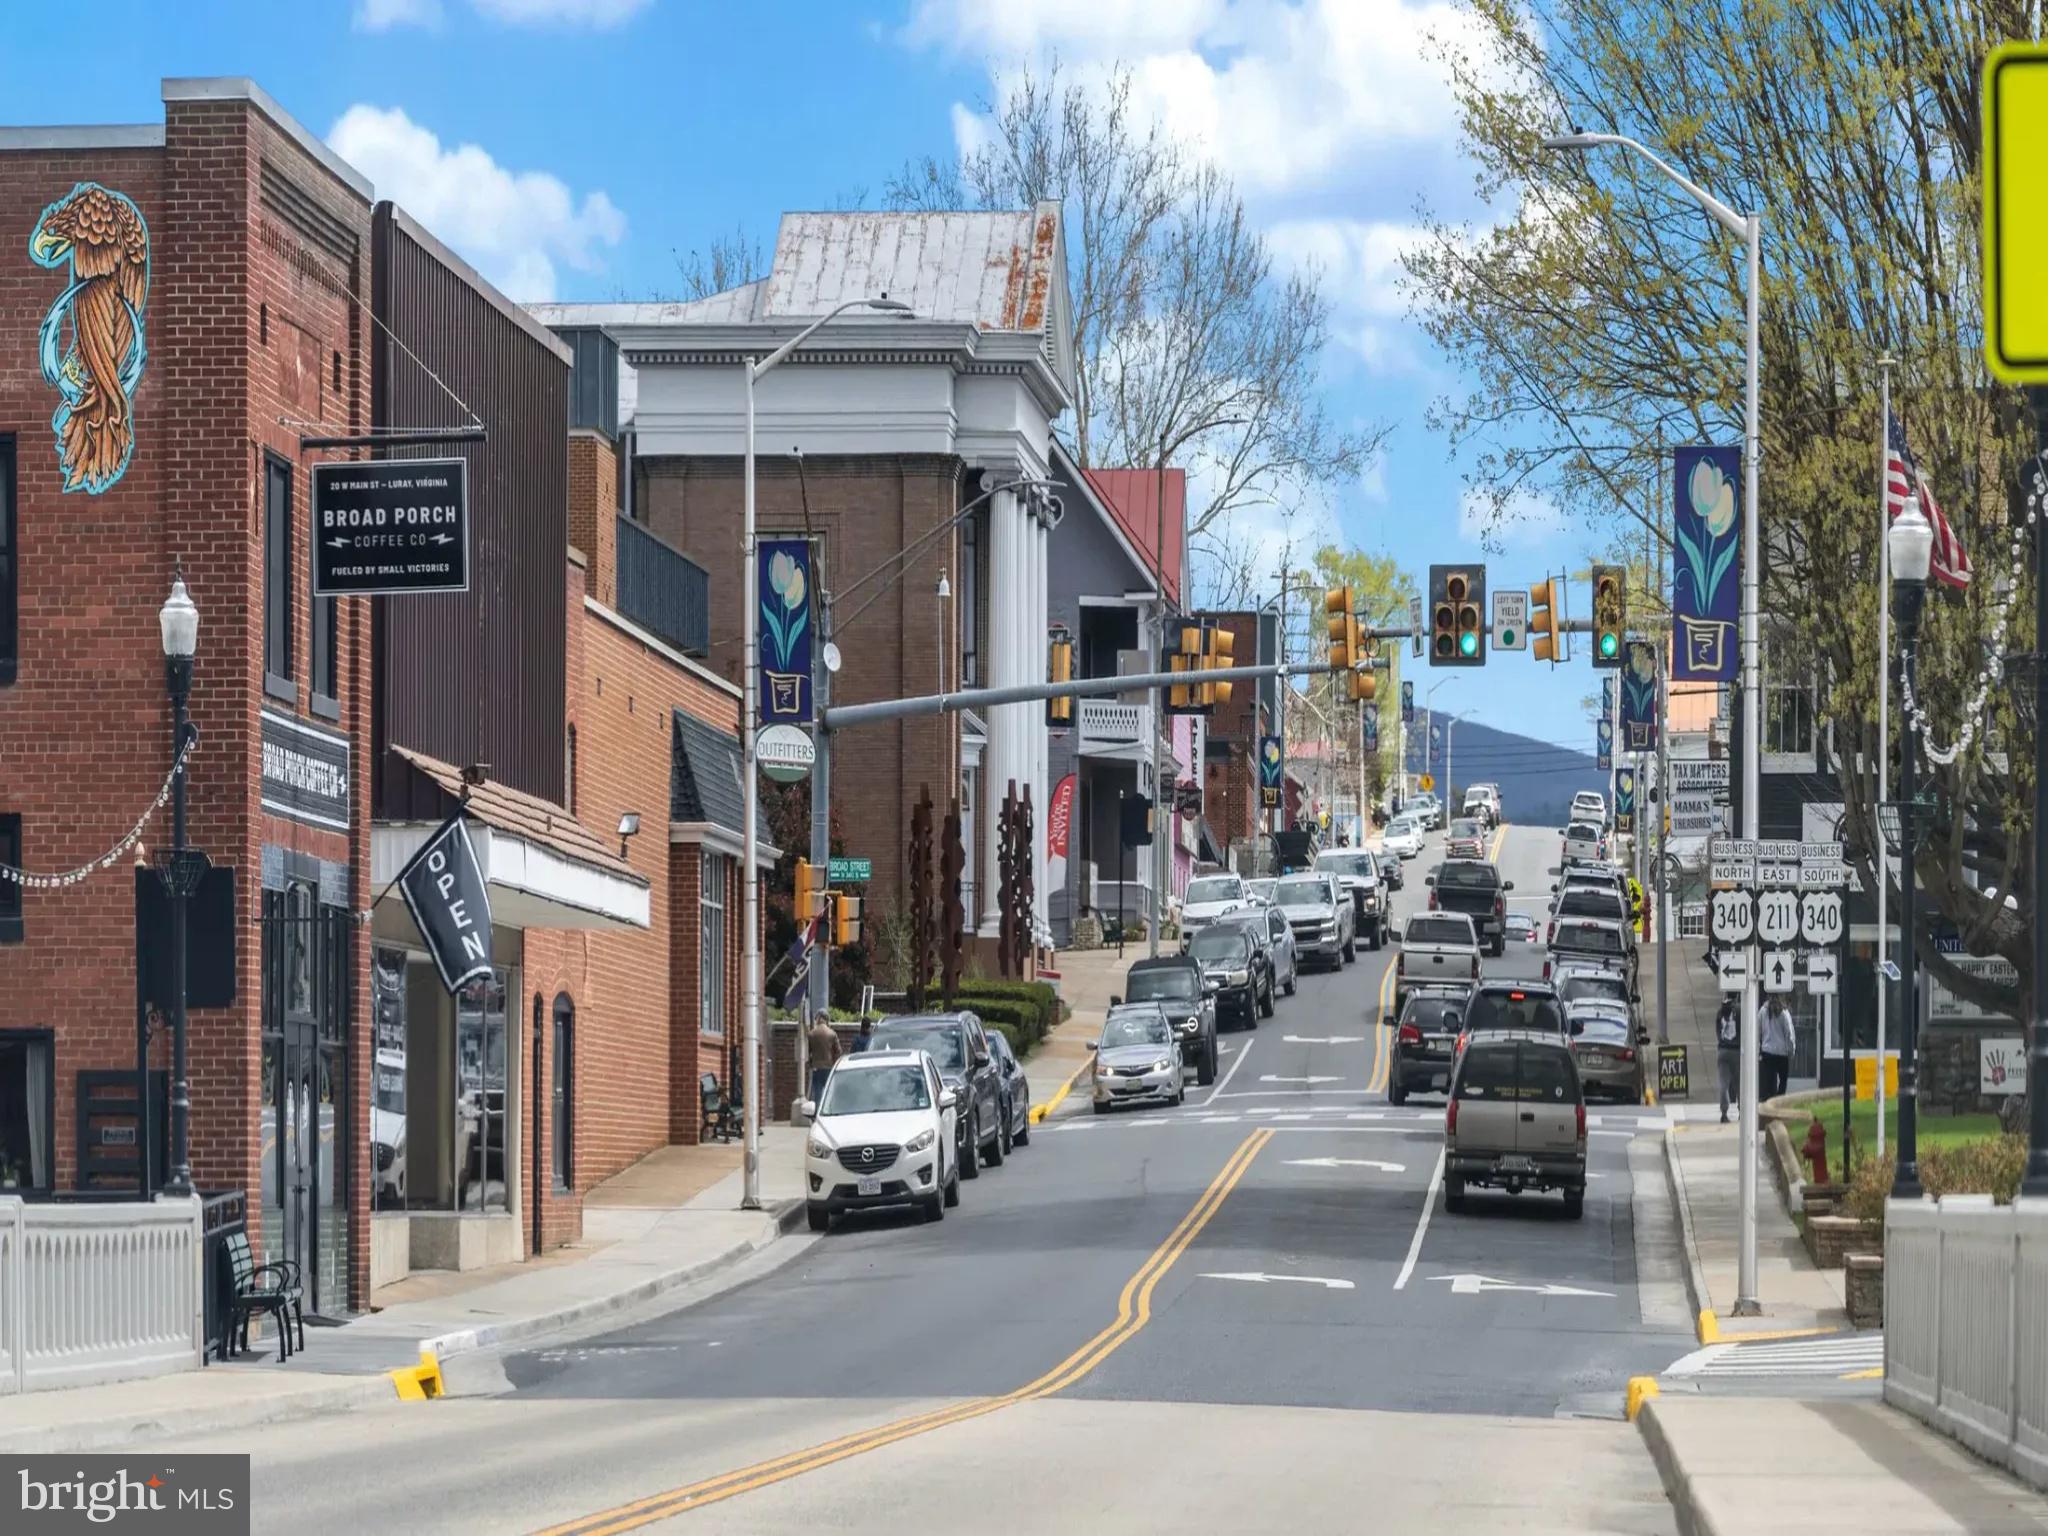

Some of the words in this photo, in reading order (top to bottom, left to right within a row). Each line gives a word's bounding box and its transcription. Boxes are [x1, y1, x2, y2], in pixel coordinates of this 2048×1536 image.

[330, 482, 340, 490] 20
[341, 482, 349, 490] W
[350, 481, 369, 490] MAIN
[370, 481, 380, 489] ST
[388, 479, 414, 489] LURAY,
[416, 477, 448, 488] VIRGINIA
[323, 508, 387, 527] BROAD
[394, 505, 456, 525] PORCH
[354, 534, 405, 548] COFFEE
[410, 533, 427, 546] CO
[332, 566, 364, 576] FUELED
[365, 565, 376, 575] BY
[377, 564, 405, 574] SMALL
[407, 562, 450, 574] VICTORIES
[1501, 606, 1520, 617] YIELD
[758, 741, 814, 760] OUTFITTERS
[263, 741, 285, 782] BROAD
[306, 756, 329, 796] COFFEE
[1673, 763, 1688, 778] TAX
[1689, 763, 1727, 779] MATTERS
[1674, 800, 1710, 813] MAMA'S
[1057, 785, 1071, 846] INVITED
[1673, 816, 1712, 830] TREASURES
[1714, 841, 1753, 855] BUSINESS
[1757, 844, 1797, 857] BUSINESS
[1801, 845, 1841, 858] BUSINESS
[829, 860, 849, 872] BROAD
[850, 860, 870, 872] STREET
[1715, 867, 1750, 879] NORTH
[1763, 869, 1792, 880] EAST
[1804, 870, 1839, 881] SOUTH
[428, 850, 485, 961] OPEN
[1717, 903, 1748, 930] 340
[1766, 904, 1790, 930] 211
[1807, 904, 1838, 931] 340
[1934, 938, 1965, 953] UNITE
[1961, 962, 1985, 976] HAPPY
[1661, 1058, 1684, 1075] ART
[1660, 1074, 1686, 1089] OPEN
